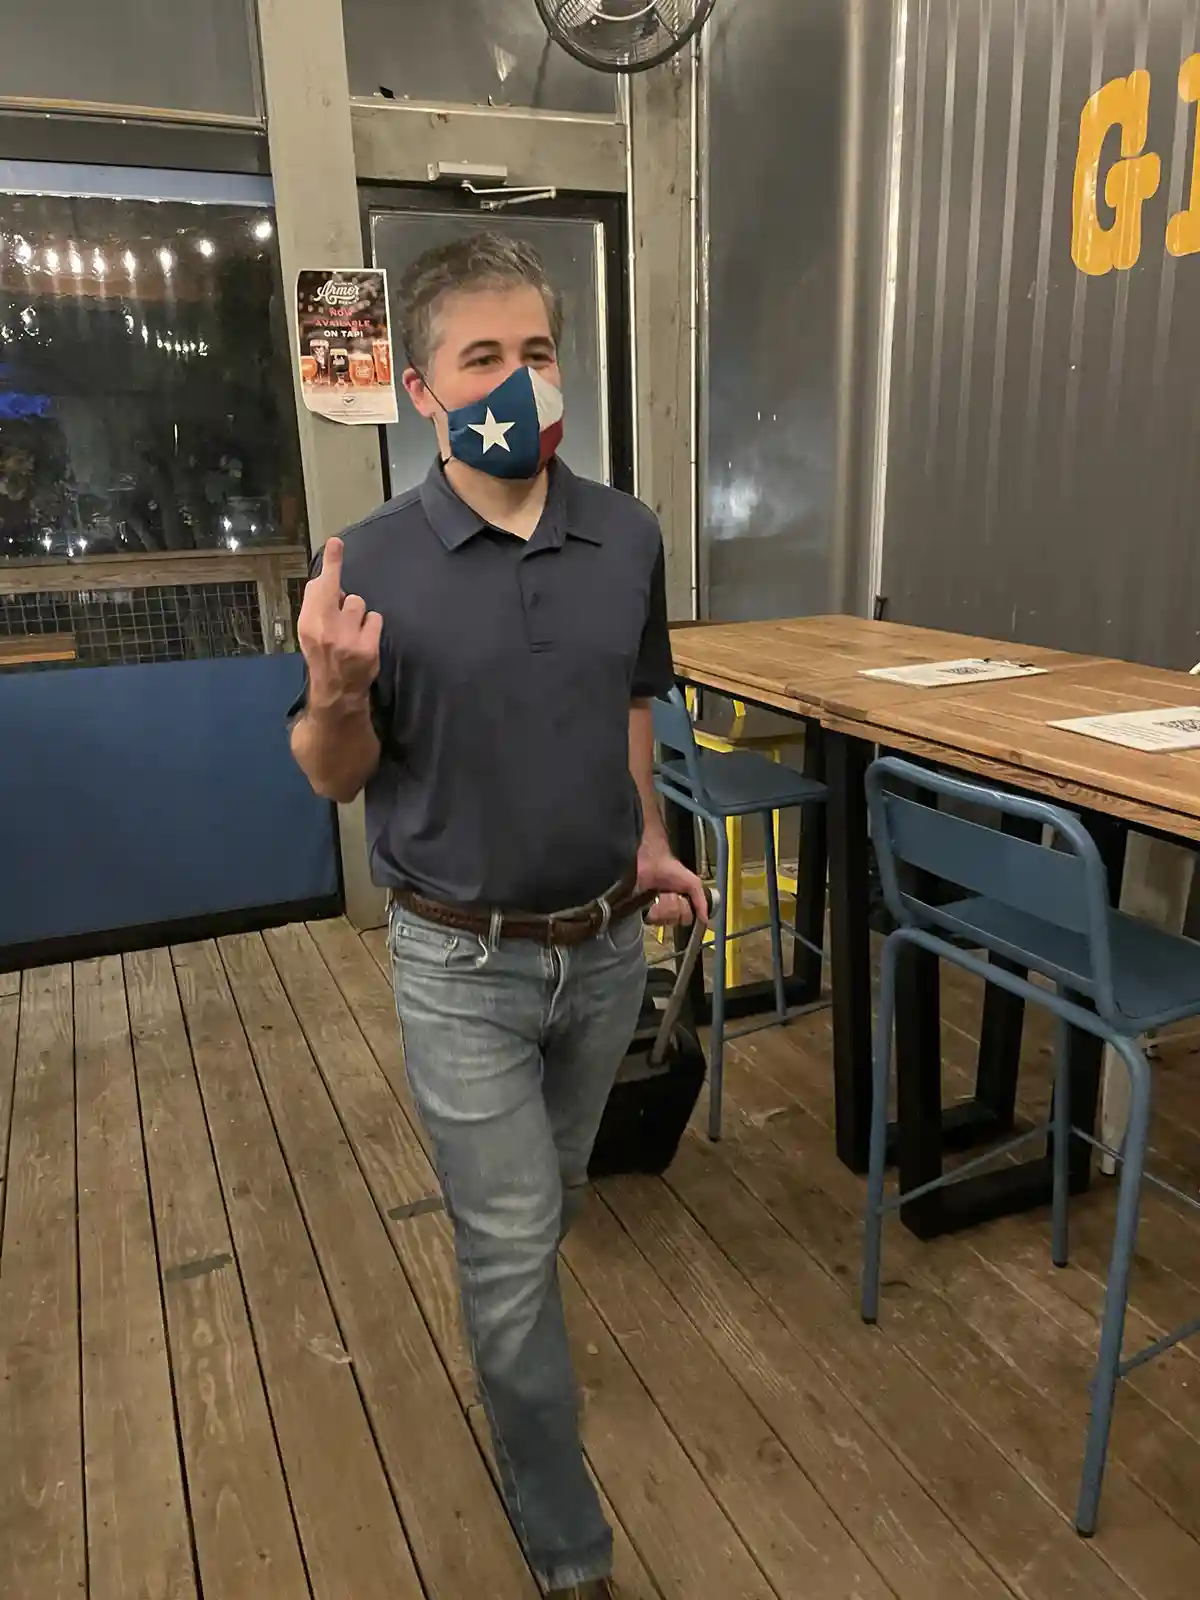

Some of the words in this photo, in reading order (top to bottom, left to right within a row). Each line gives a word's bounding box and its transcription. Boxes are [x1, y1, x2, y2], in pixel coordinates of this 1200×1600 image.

[313, 280, 360, 305] Armor
[329, 308, 352, 317] NOW
[315, 319, 371, 328] AVAILABLE
[323, 330, 338, 338] ON
